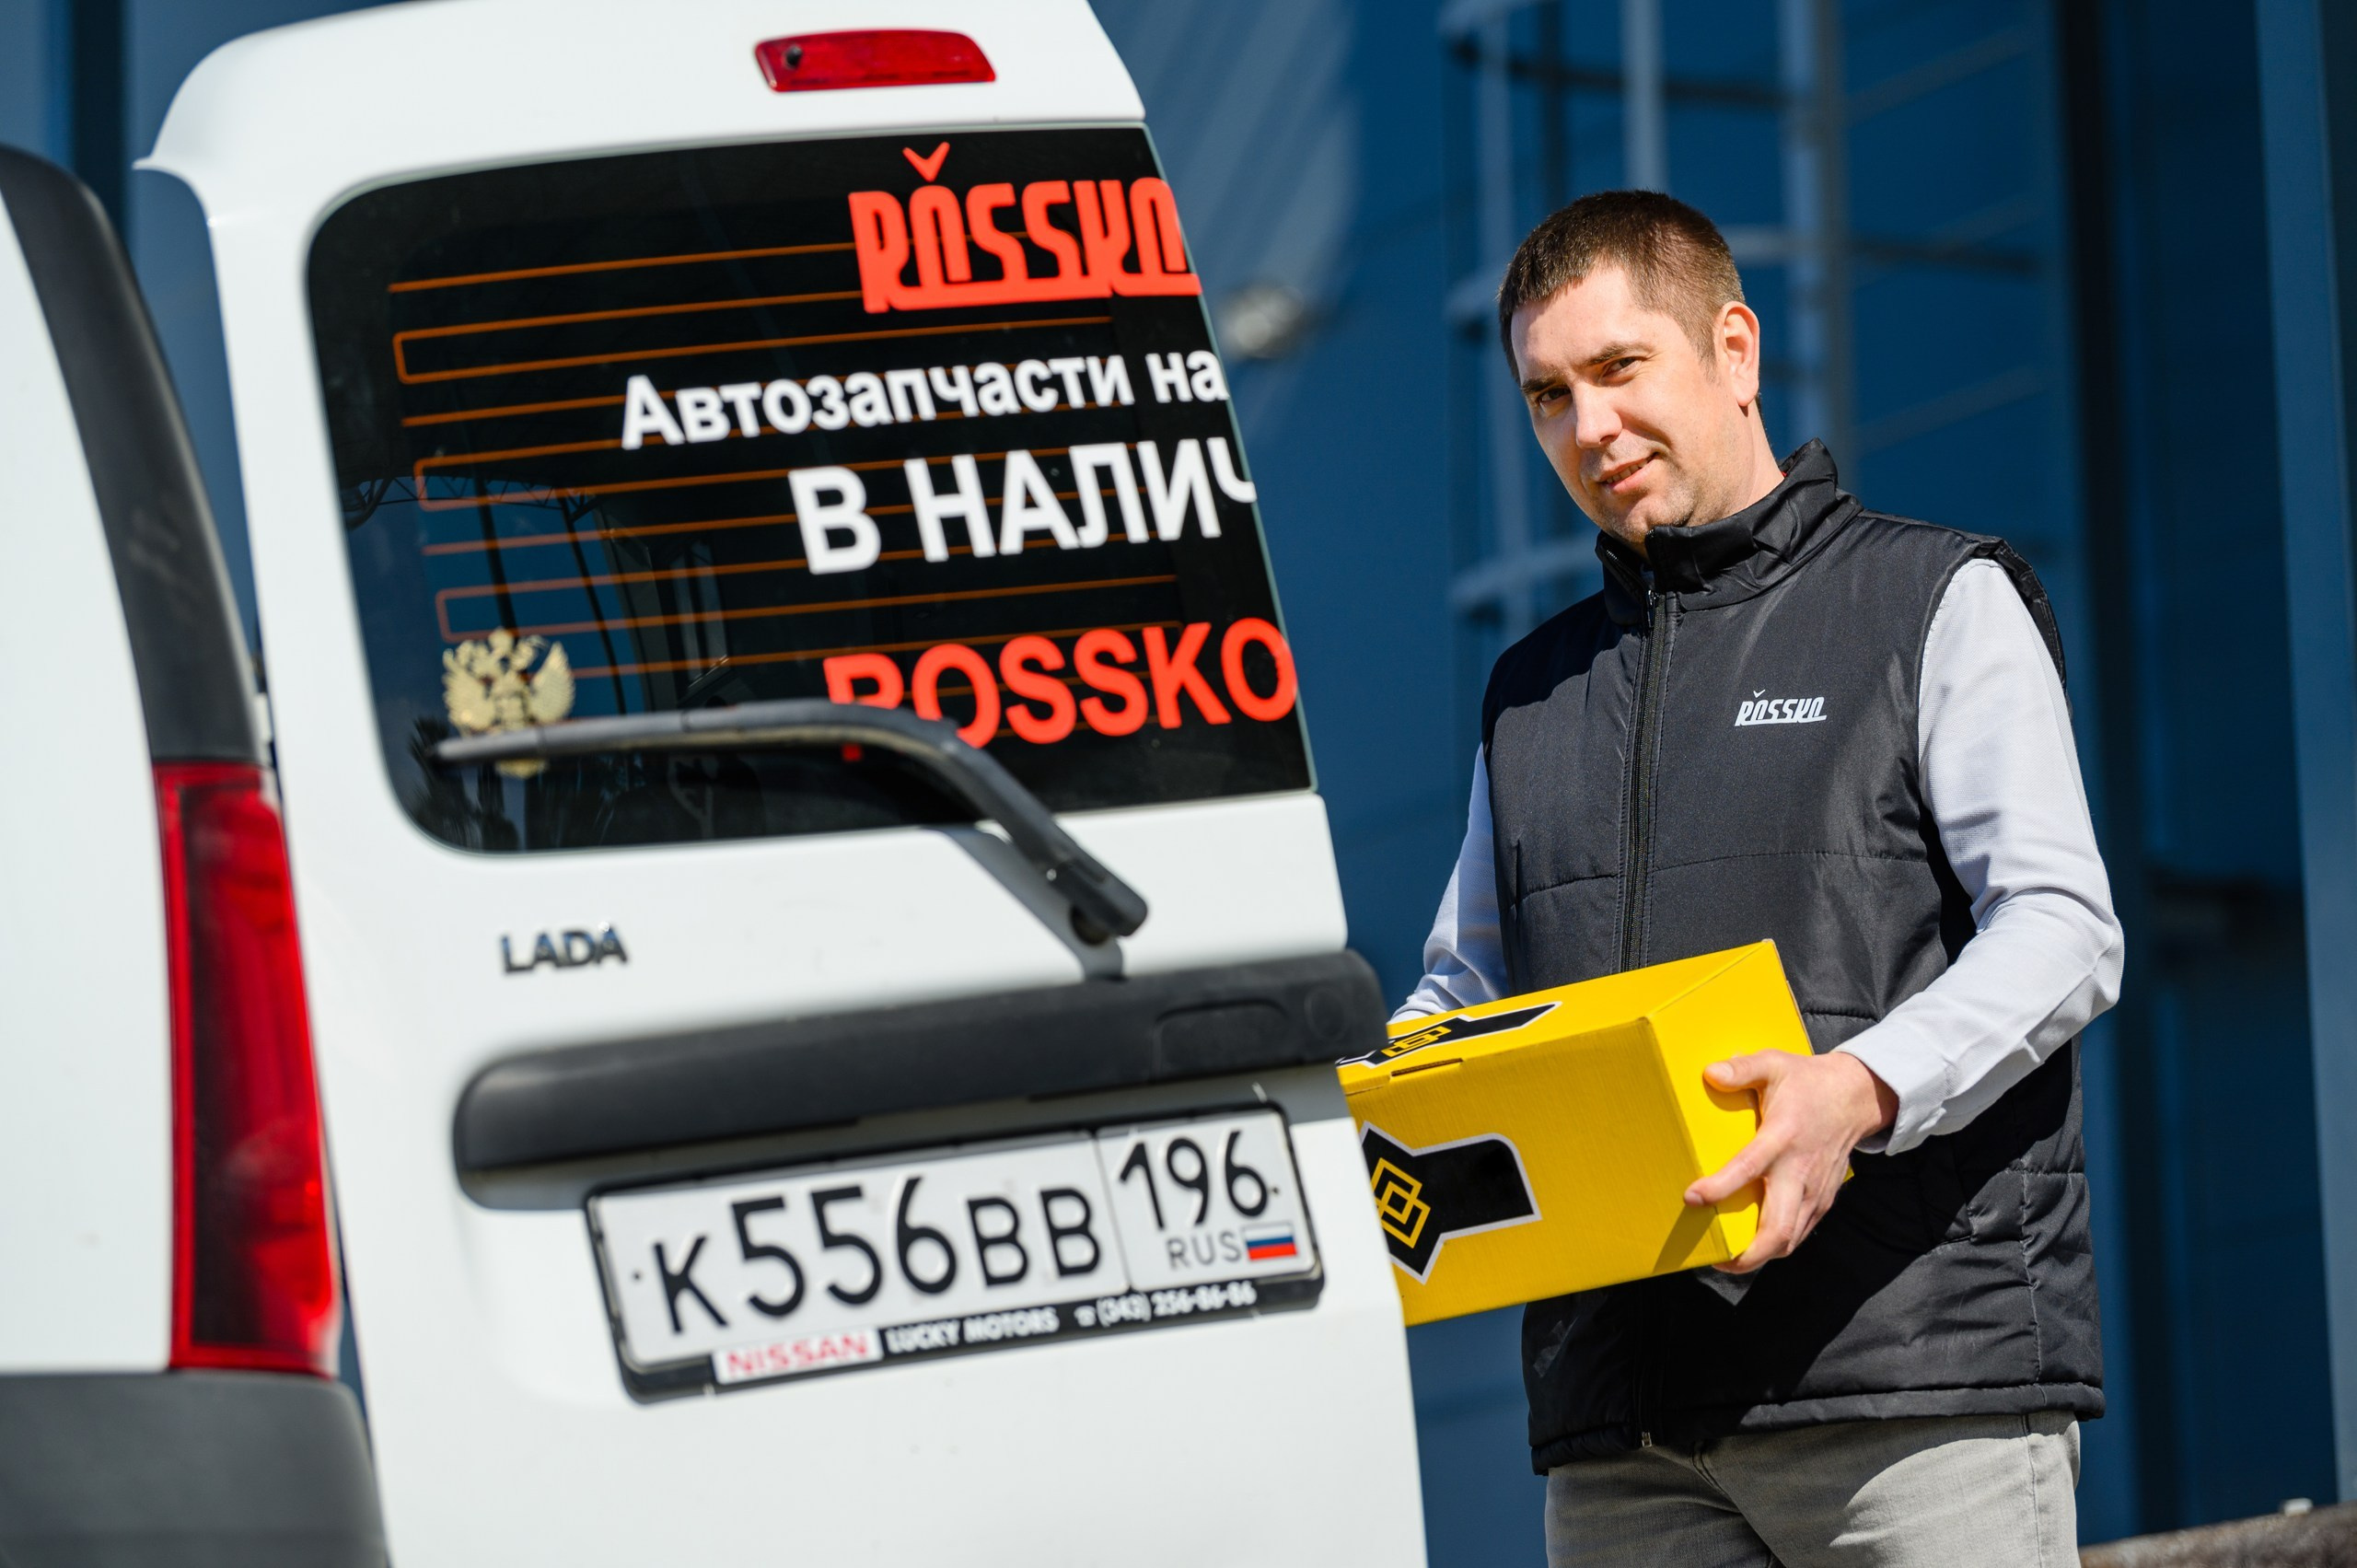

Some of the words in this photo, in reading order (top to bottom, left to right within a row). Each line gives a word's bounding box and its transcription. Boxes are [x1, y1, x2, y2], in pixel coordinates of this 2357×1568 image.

[621, 354, 1134, 450] Автозапчасти
[1144, 349, 1230, 403] на
[788, 465, 882, 575] В
[501, 924, 629, 974] LADA
[1118, 1130, 1269, 1231] 196
[1167, 1230, 1242, 1269] RUS
[726, 1330, 868, 1375] NISSAN
[886, 1318, 959, 1354] LUCKY
[963, 1306, 1059, 1343] MOTORS
